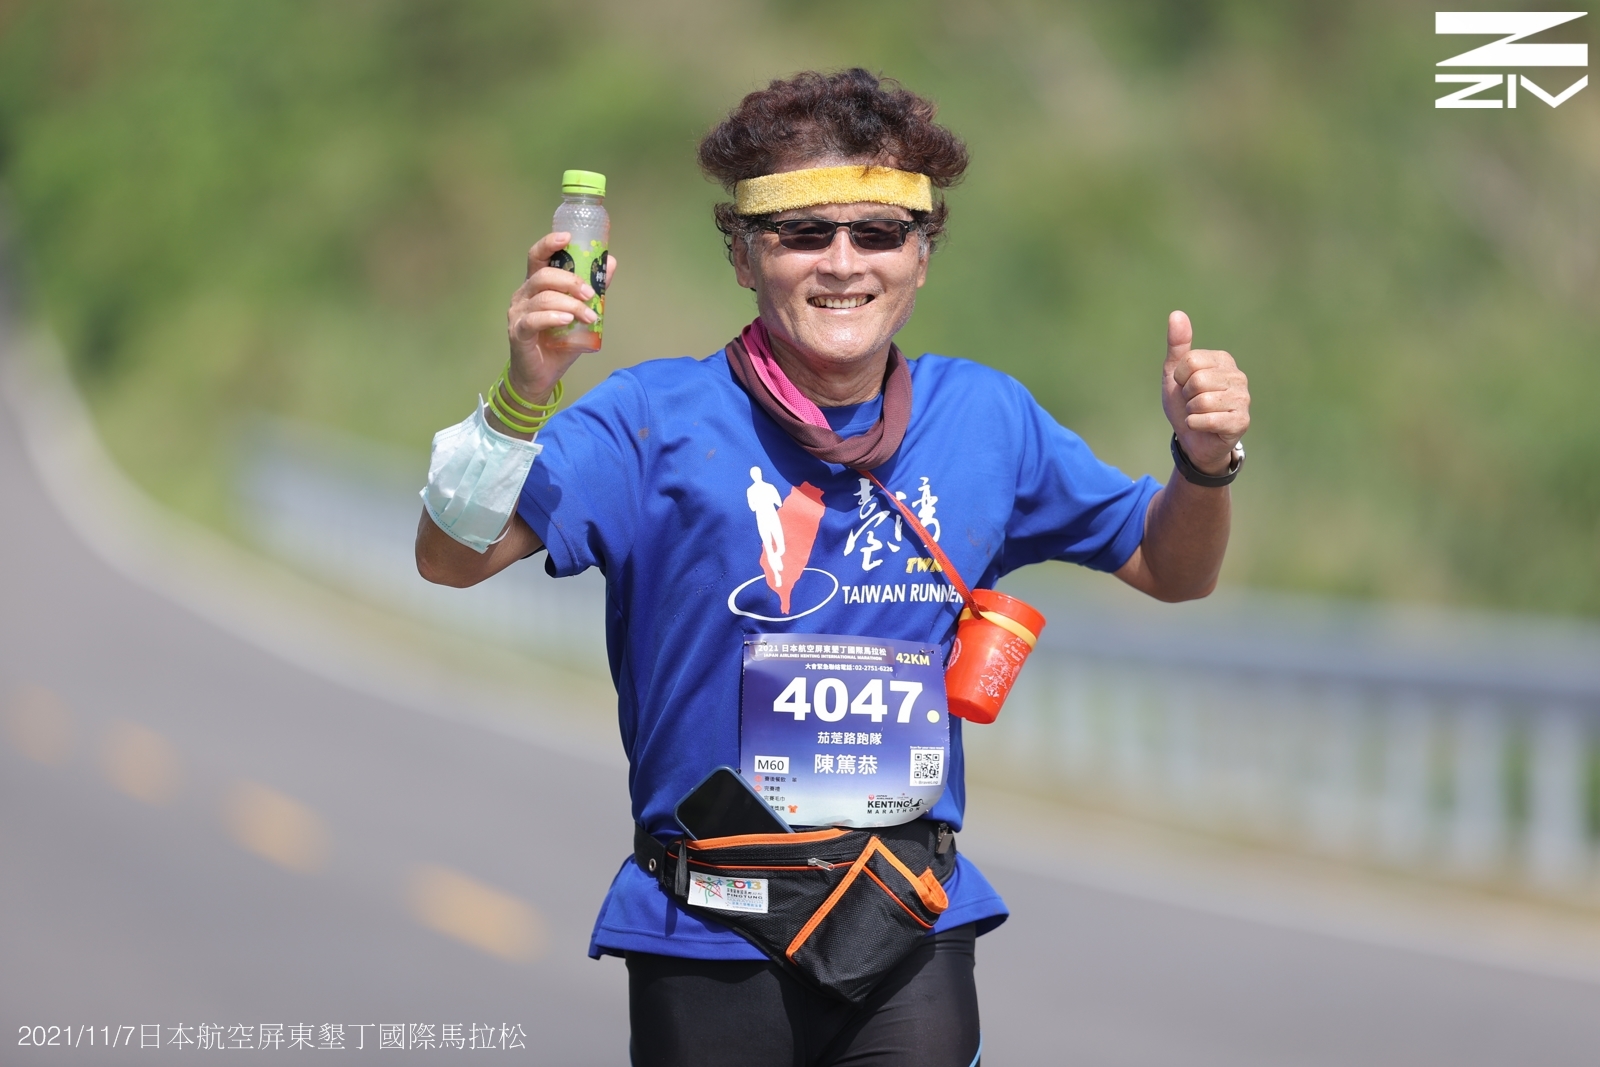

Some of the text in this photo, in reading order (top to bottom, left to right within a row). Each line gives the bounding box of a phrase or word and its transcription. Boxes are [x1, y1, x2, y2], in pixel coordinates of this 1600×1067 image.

[842, 584, 906, 605] TAIWAN
[758, 644, 779, 654] 2021
[896, 651, 931, 667] 42KM
[773, 677, 923, 723] 4047
[757, 759, 785, 771] M60
[814, 753, 878, 775] 陳篤恭
[867, 800, 910, 809] KENTING
[867, 807, 920, 815] MARATHON
[726, 879, 762, 890] 2013
